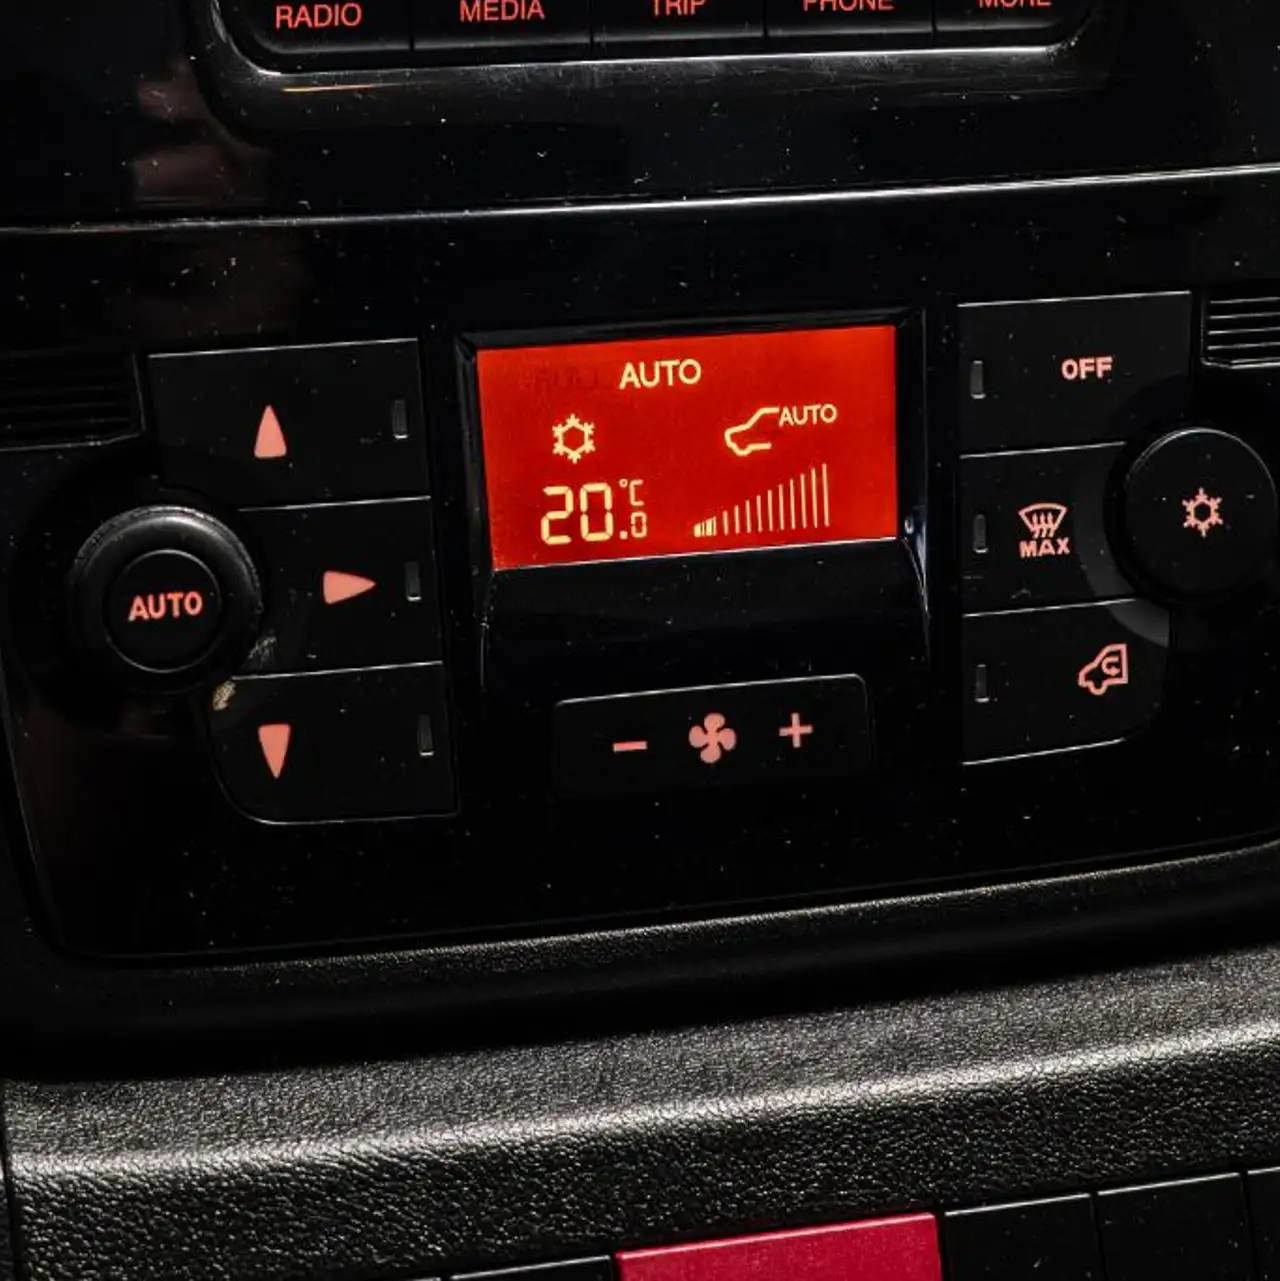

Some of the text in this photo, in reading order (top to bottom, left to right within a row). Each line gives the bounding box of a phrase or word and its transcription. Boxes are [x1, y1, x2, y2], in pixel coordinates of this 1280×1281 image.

[275, 1, 363, 29] RADIO
[619, 358, 702, 390] AUTO
[1061, 355, 1113, 380] OFF
[778, 403, 838, 428] AUTO
[1019, 536, 1071, 558] MAX
[128, 590, 203, 622] AUTO
